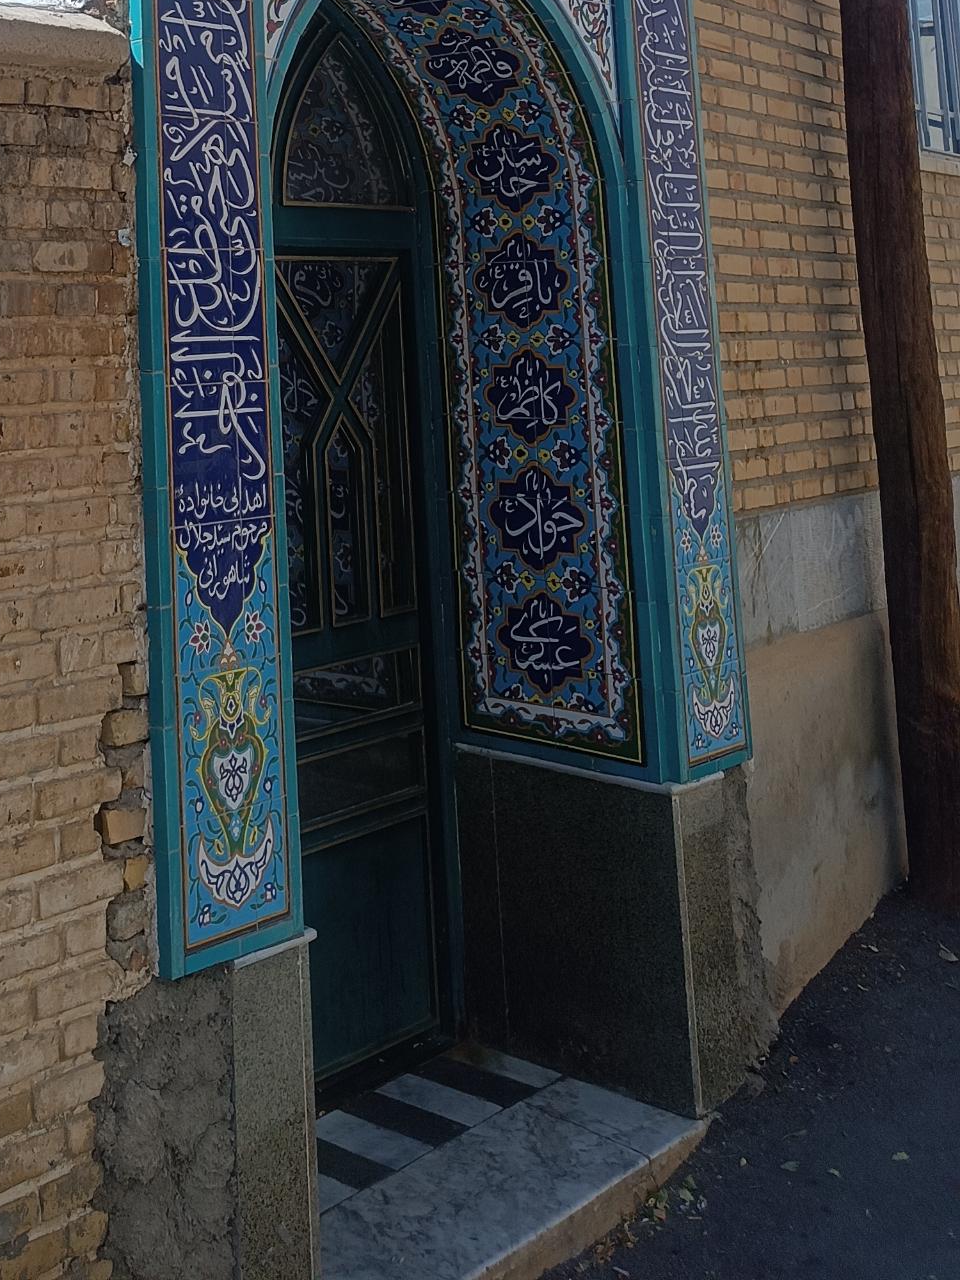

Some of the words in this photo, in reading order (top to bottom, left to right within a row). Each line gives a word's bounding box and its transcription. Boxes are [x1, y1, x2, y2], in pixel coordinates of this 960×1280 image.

[494, 129, 517, 150] امام
[507, 240, 530, 257] امام
[516, 357, 539, 376] امام
[526, 470, 546, 491] امام
[229, 521, 268, 551] مرحوم
[530, 600, 553, 618] امام
